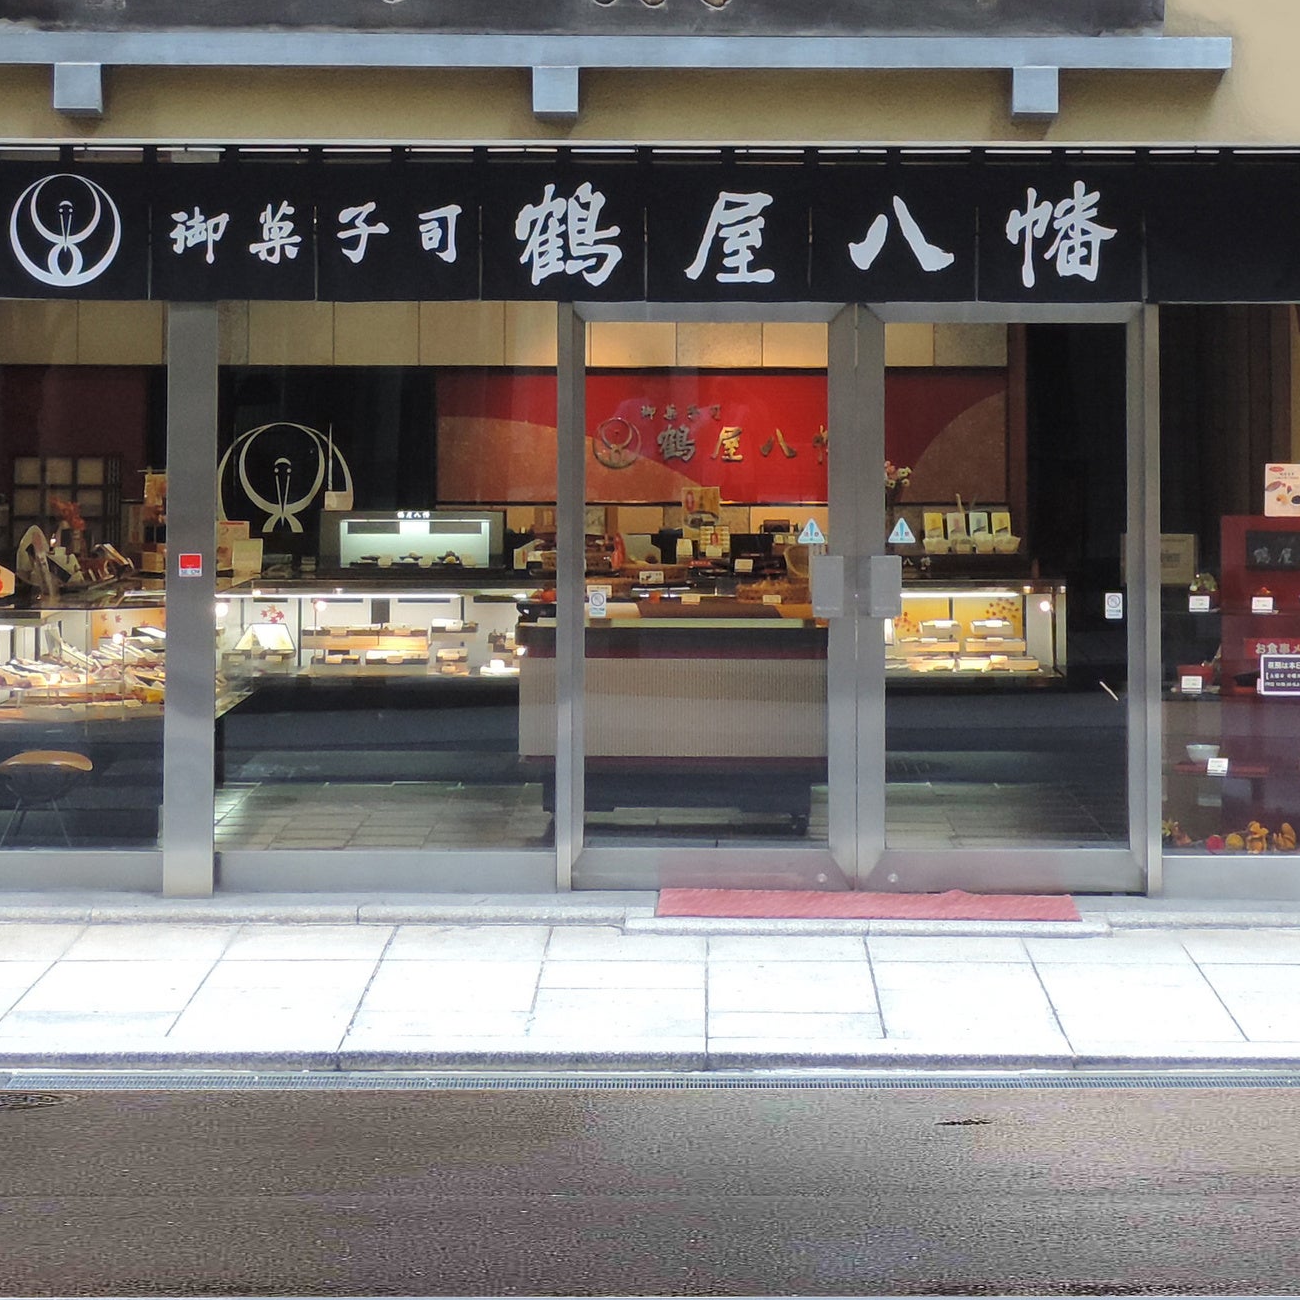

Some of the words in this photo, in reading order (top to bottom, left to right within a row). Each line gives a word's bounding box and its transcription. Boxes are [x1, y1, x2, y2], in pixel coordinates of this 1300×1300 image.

[169, 200, 462, 264] 御菓子司
[514, 180, 1118, 288] 鶴屋八幡
